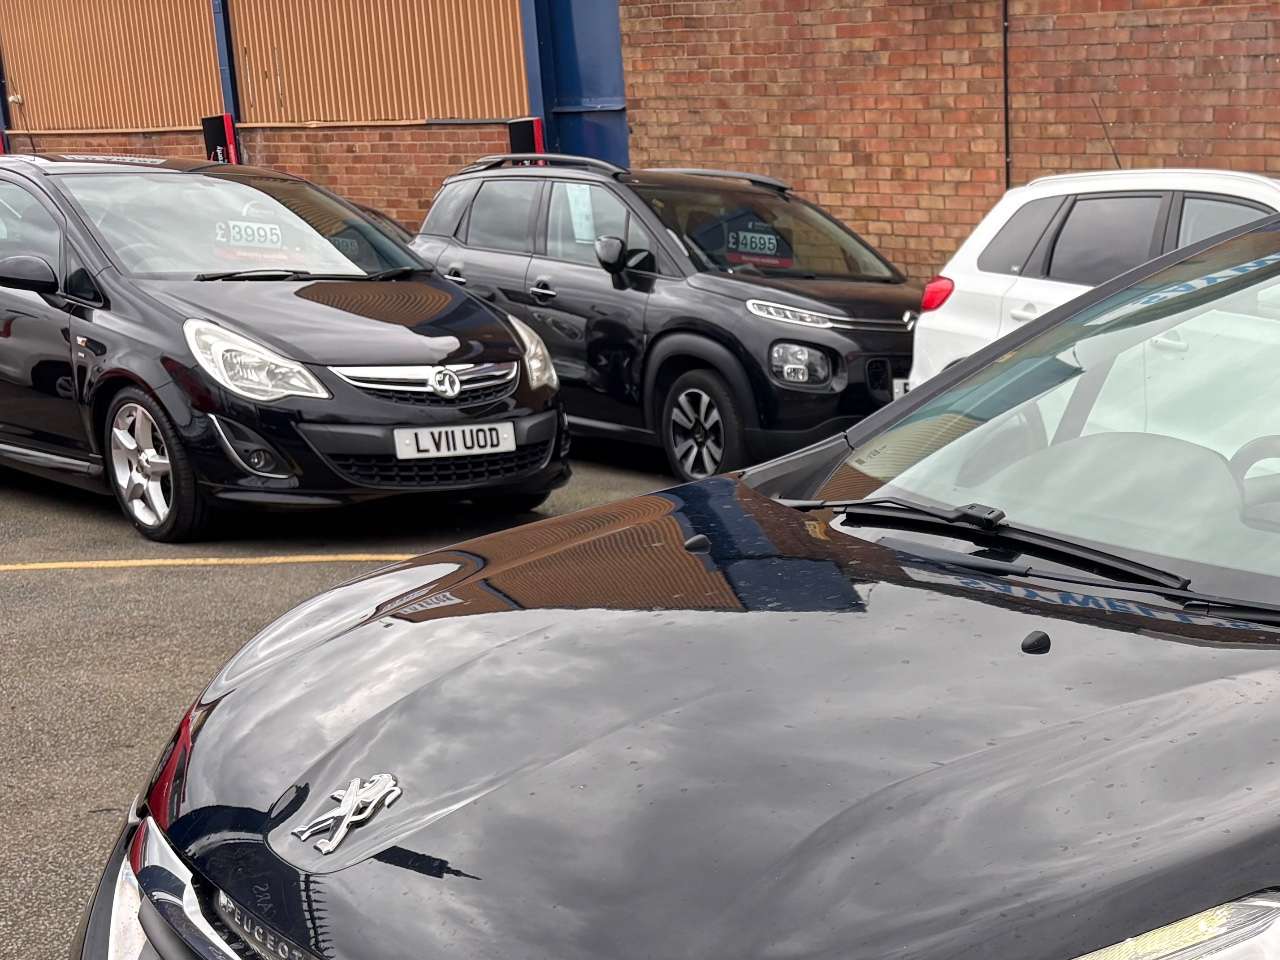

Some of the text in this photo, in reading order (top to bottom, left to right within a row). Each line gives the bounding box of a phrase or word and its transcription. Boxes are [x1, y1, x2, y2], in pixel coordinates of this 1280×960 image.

[215, 222, 281, 244] £3995
[728, 231, 776, 251] £4695
[414, 427, 500, 453] LV11 UOD
